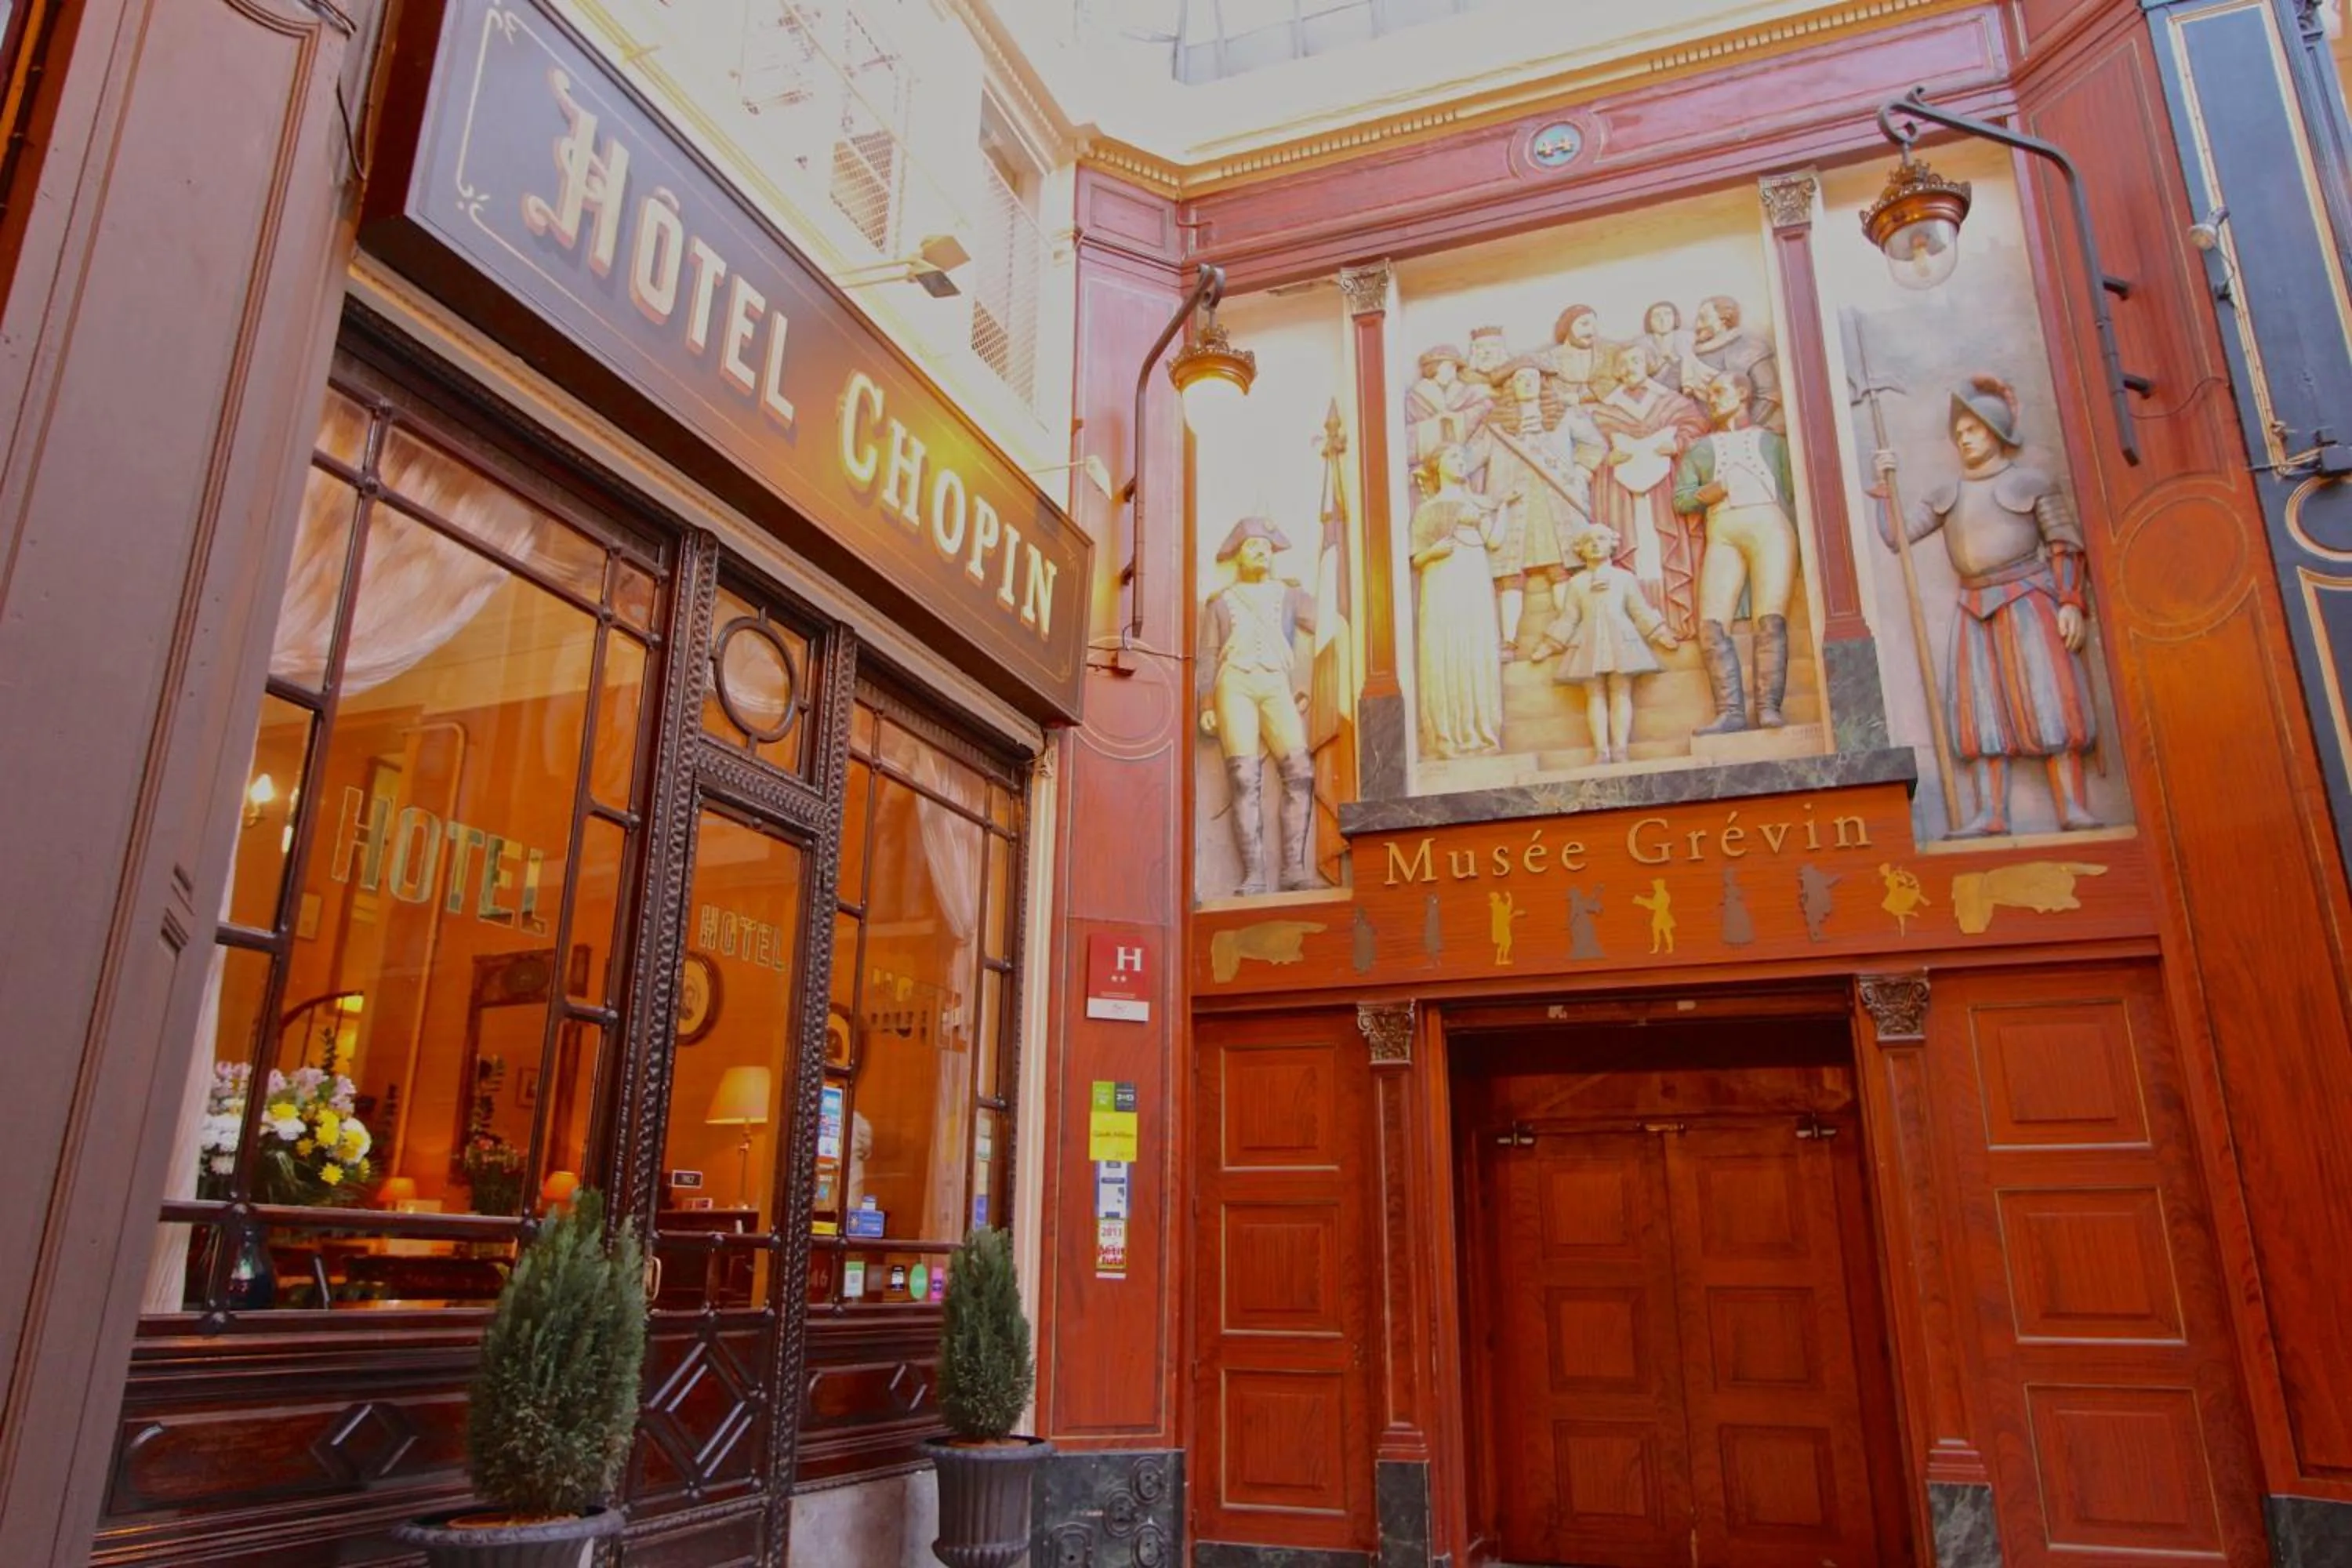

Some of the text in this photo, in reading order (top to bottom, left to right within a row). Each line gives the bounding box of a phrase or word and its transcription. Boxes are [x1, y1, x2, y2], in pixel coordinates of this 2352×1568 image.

[521, 64, 1058, 637] HÔTEL CHOPIN
[331, 786, 547, 937] HOTEL
[1383, 802, 1872, 887] Musée Grévin
[699, 903, 786, 971] HOTEL
[1116, 946, 1143, 971] H
